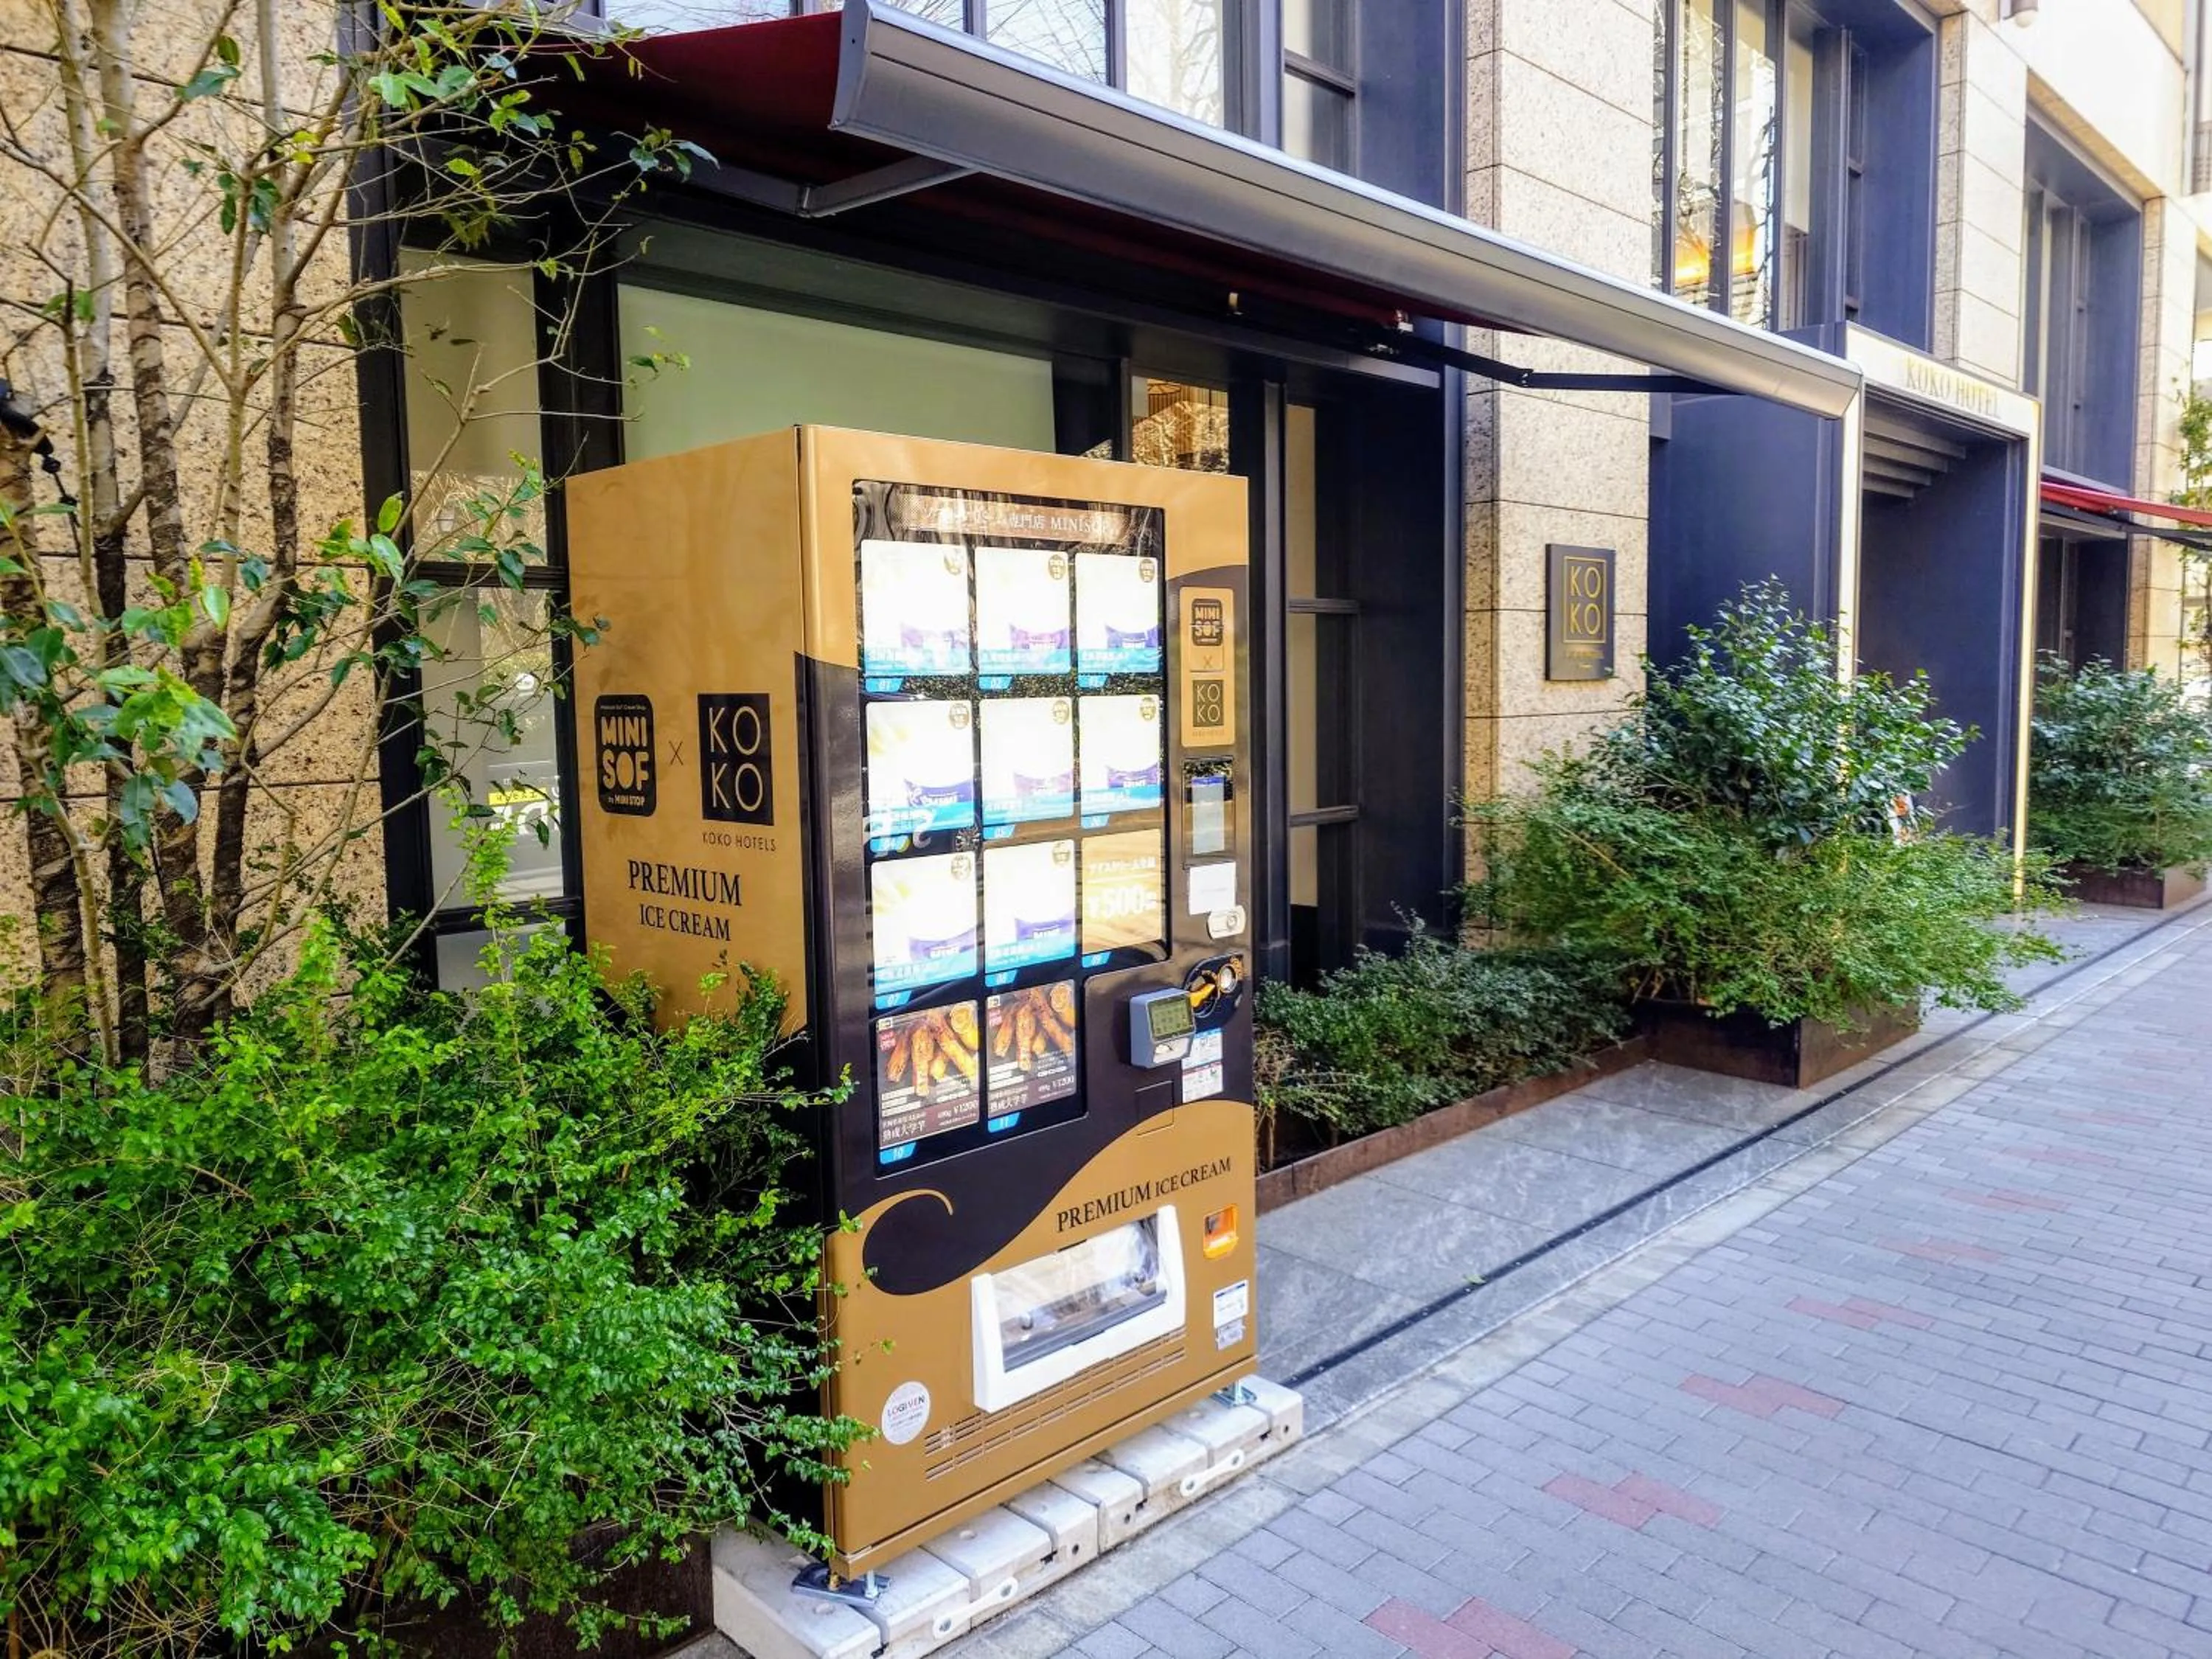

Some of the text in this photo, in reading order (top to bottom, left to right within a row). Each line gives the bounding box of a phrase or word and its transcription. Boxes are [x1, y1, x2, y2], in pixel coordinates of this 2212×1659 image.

[1906, 354, 2002, 420] KOKO HOTEL
[1570, 566, 1601, 599] KO
[1193, 620, 1222, 637] SOF
[1194, 607, 1221, 620] MINI
[1570, 602, 1601, 635] KO
[1196, 684, 1220, 703] KO
[1196, 704, 1220, 723] KO
[600, 716, 647, 747] MINI
[708, 705, 761, 757] KO
[602, 748, 650, 791] SOF
[711, 762, 763, 812] KO
[702, 831, 776, 852] KOKO HOTELS
[627, 859, 742, 907] PREMIUM
[639, 903, 731, 942] ICE CREAM
[1056, 1156, 1231, 1234] PREMIUM ICE CREAM
